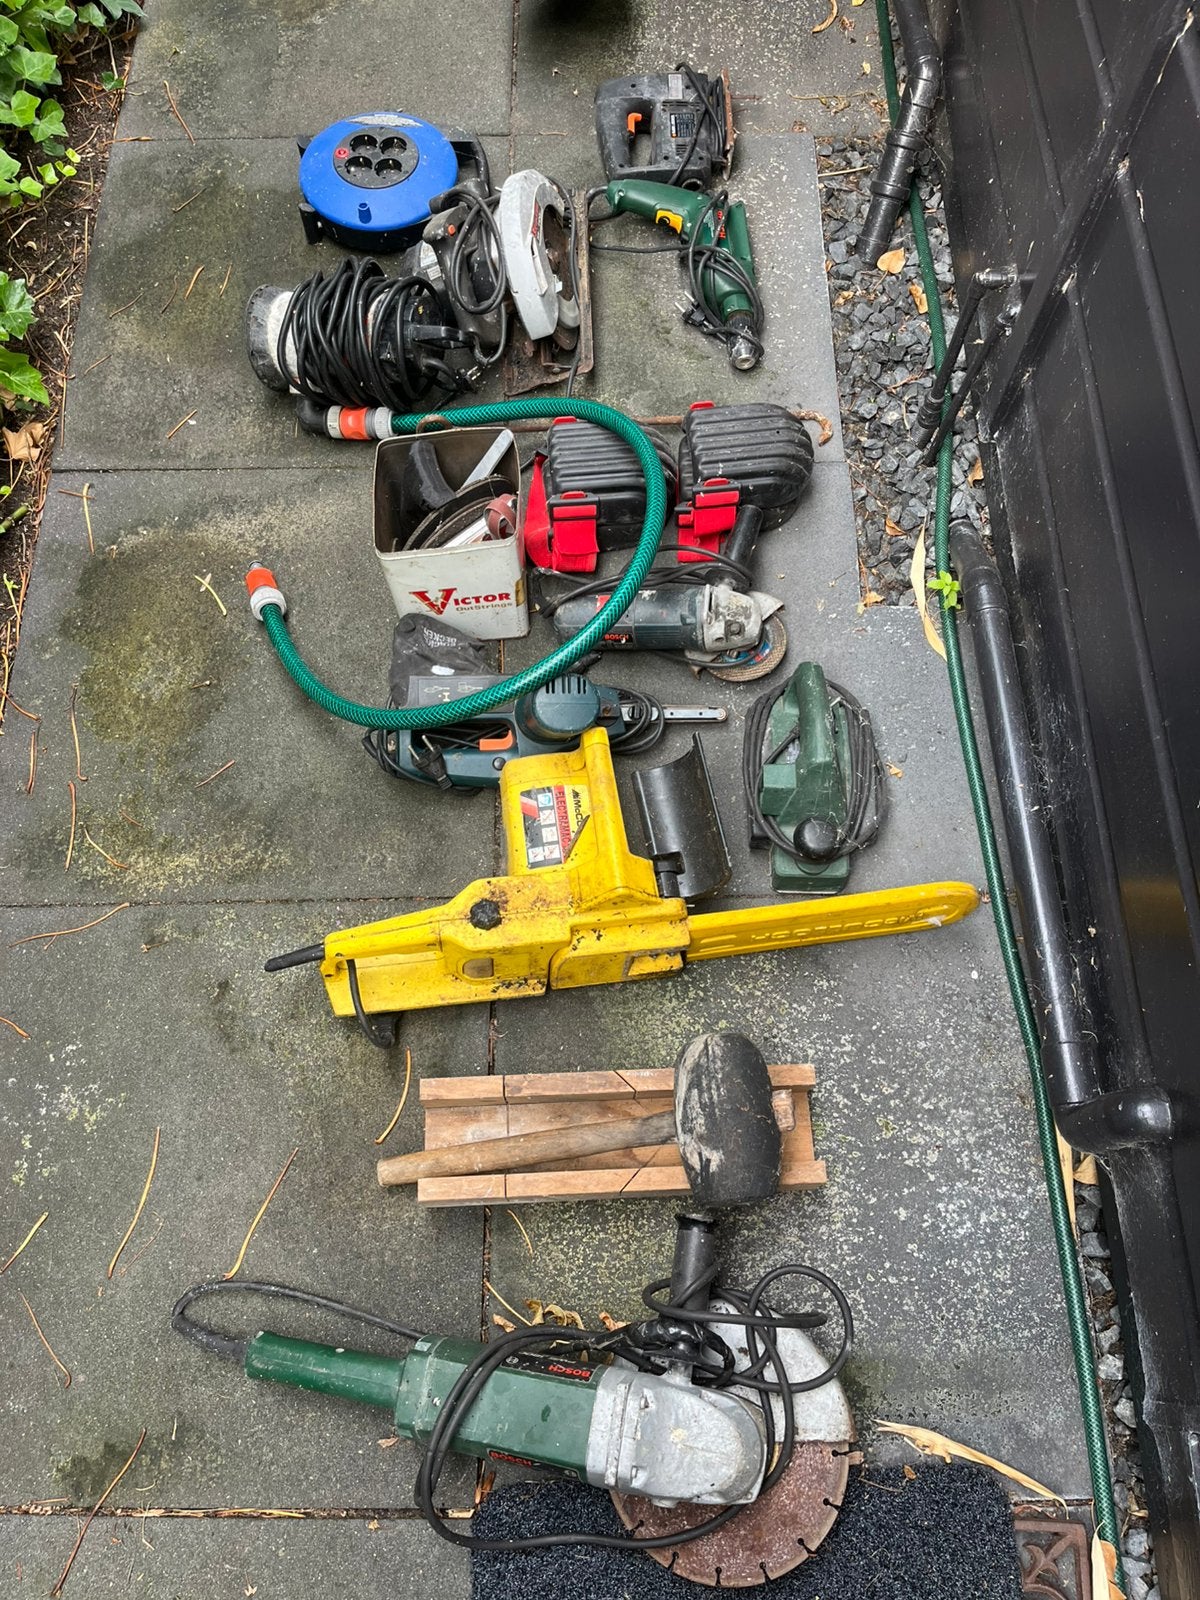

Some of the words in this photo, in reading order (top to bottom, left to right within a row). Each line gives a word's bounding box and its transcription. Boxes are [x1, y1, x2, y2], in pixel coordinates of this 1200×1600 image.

[408, 587, 511, 615] VICTOR
[455, 602, 513, 612] OutStrings
[547, 1363, 591, 1377] BOSCH
